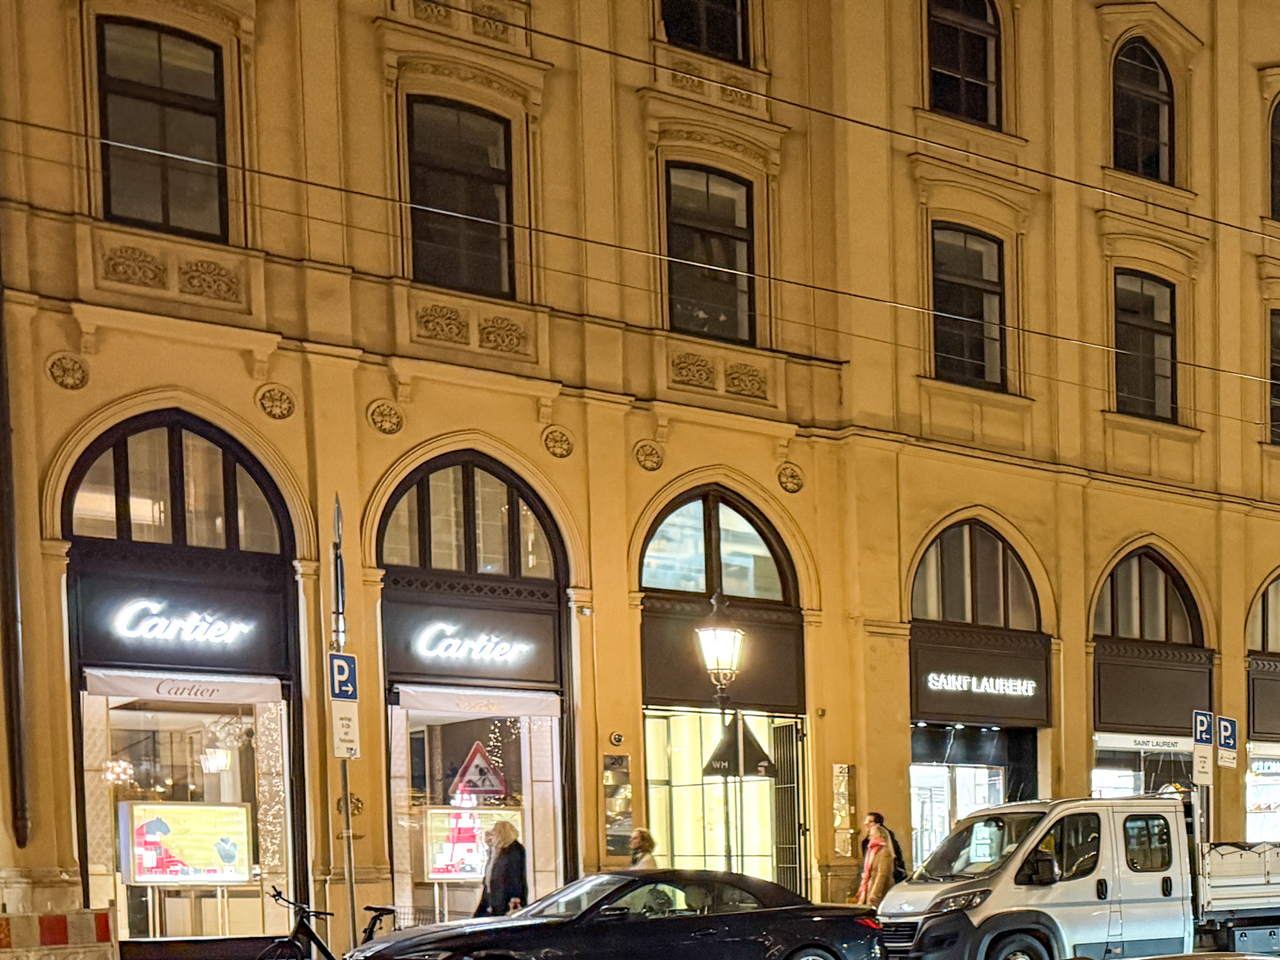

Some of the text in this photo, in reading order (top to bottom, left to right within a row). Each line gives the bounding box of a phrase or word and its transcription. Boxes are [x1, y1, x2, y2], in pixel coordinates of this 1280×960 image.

[114, 599, 253, 644] Cartier
[416, 621, 535, 662] Cartier
[156, 678, 220, 699] Cartier
[333, 659, 349, 694] P
[927, 673, 1037, 696] SAINT LAURENT
[1196, 715, 1208, 740] P
[1220, 720, 1232, 745] P
[1133, 739, 1179, 748] SAINT LAURENT
[611, 757, 624, 767] 20
